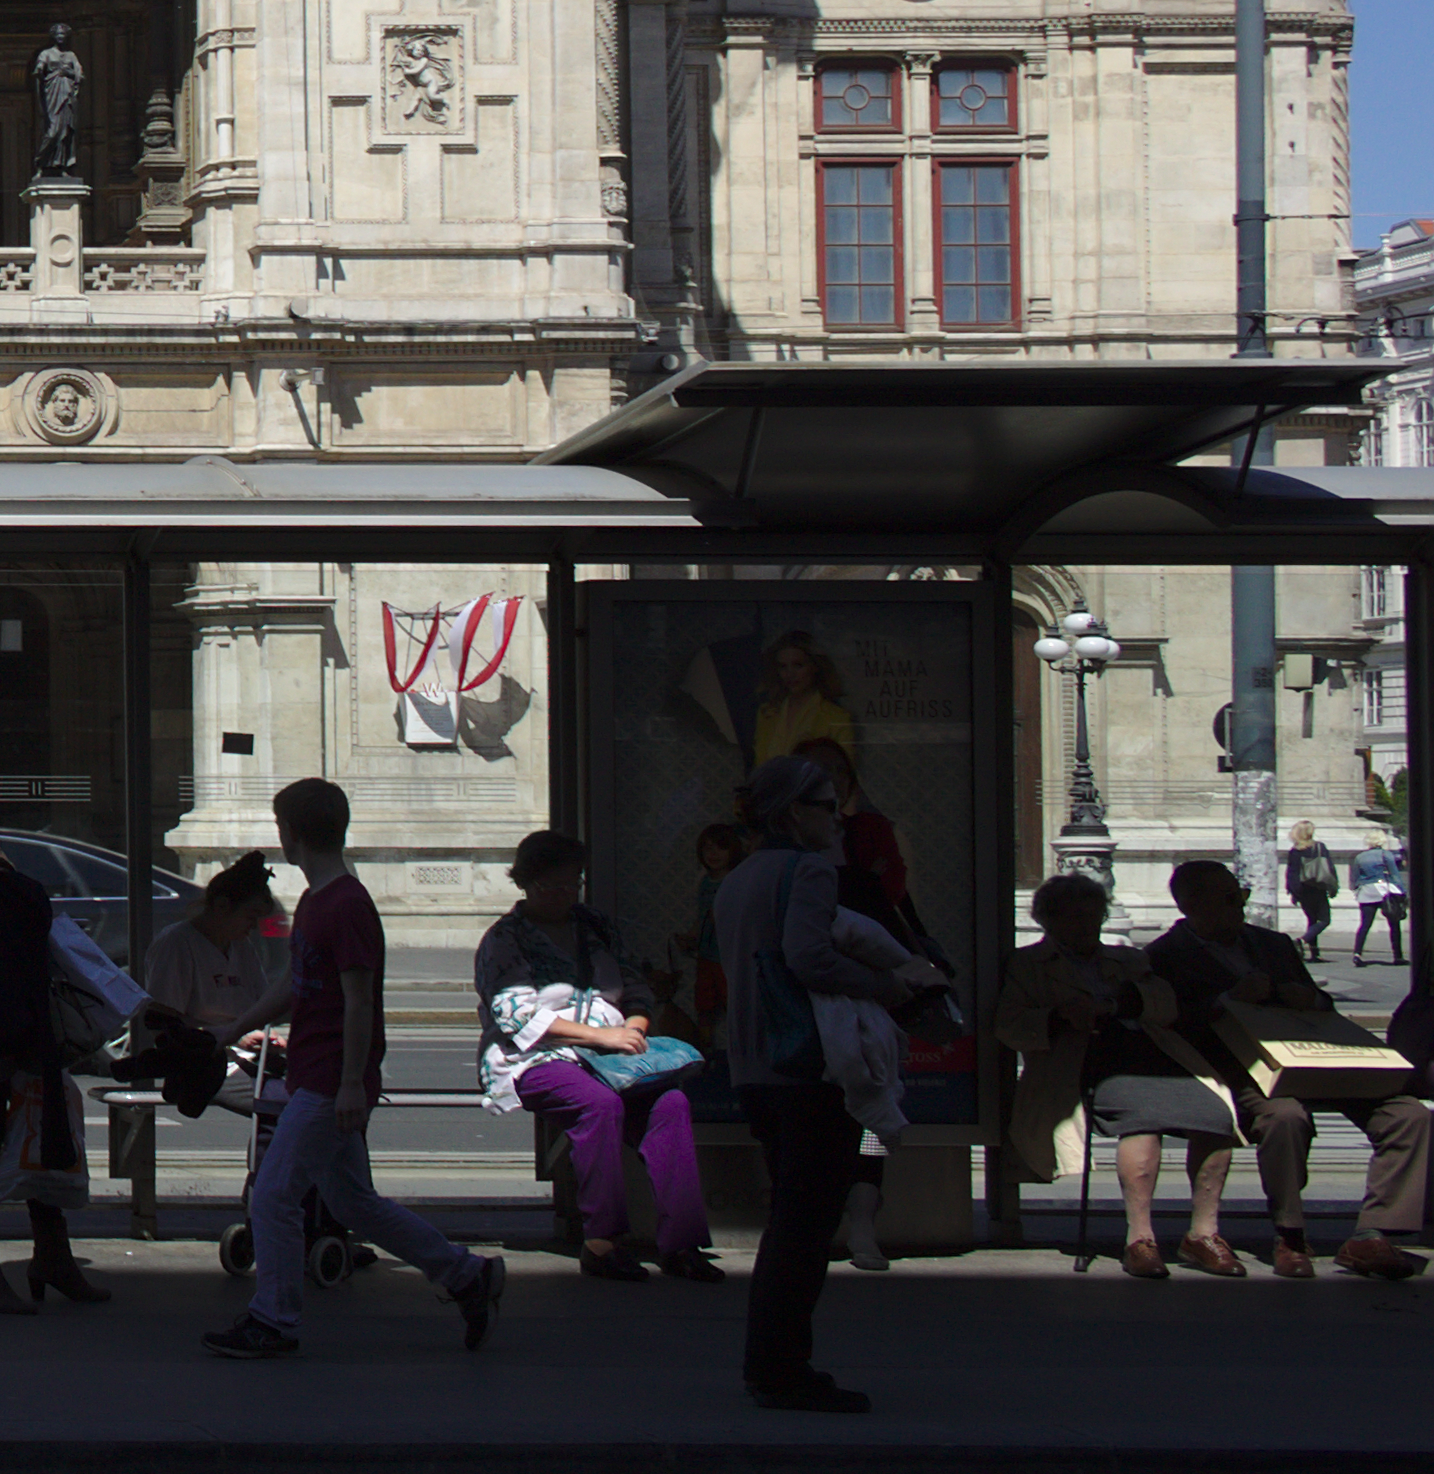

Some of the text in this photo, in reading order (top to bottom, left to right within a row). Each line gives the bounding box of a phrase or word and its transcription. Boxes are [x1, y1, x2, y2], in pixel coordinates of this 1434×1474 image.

[854, 639, 889, 657] MIT
[865, 659, 928, 677] MAMA
[880, 679, 919, 698] AUF
[865, 699, 953, 719] AUFRISS
